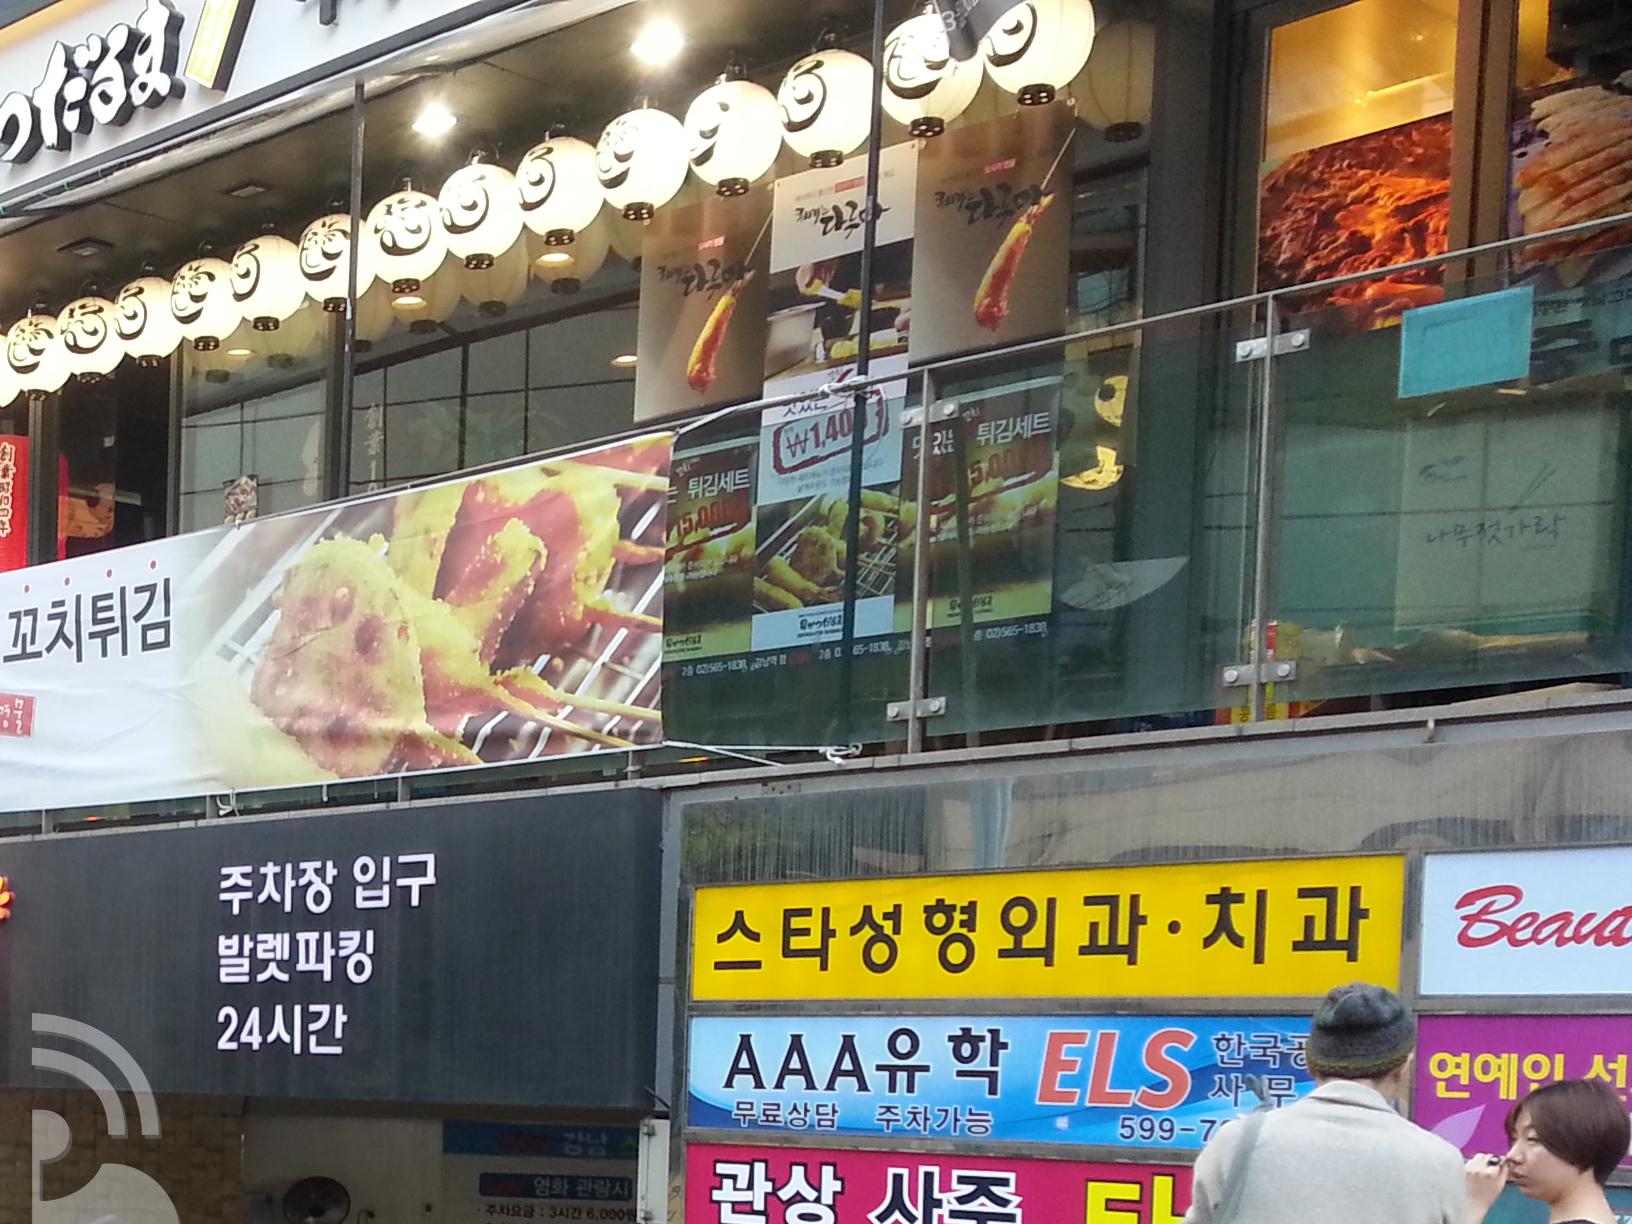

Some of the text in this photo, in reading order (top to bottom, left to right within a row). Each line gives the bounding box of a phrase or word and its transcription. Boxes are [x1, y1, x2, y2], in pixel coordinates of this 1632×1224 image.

[976, 411, 1052, 447] 튀김세트
[687, 467, 751, 500] 튀김세트
[2, 576, 172, 666] 꼬치튀김
[217, 852, 438, 915] 주차장 입구
[216, 929, 375, 985] 발렛파킹
[216, 1003, 349, 1056] 24시간
[1036, 1027, 1199, 1111] ELS
[1428, 1051, 1566, 1100] 연예인
[732, 1100, 995, 1137] 무료상담 주차가능
[1118, 1115, 1231, 1145] 599-7
[533, 1175, 630, 1199] 영화 관람시
[484, 1204, 536, 1219] 주차요금
[548, 1206, 583, 1220] 3시간
